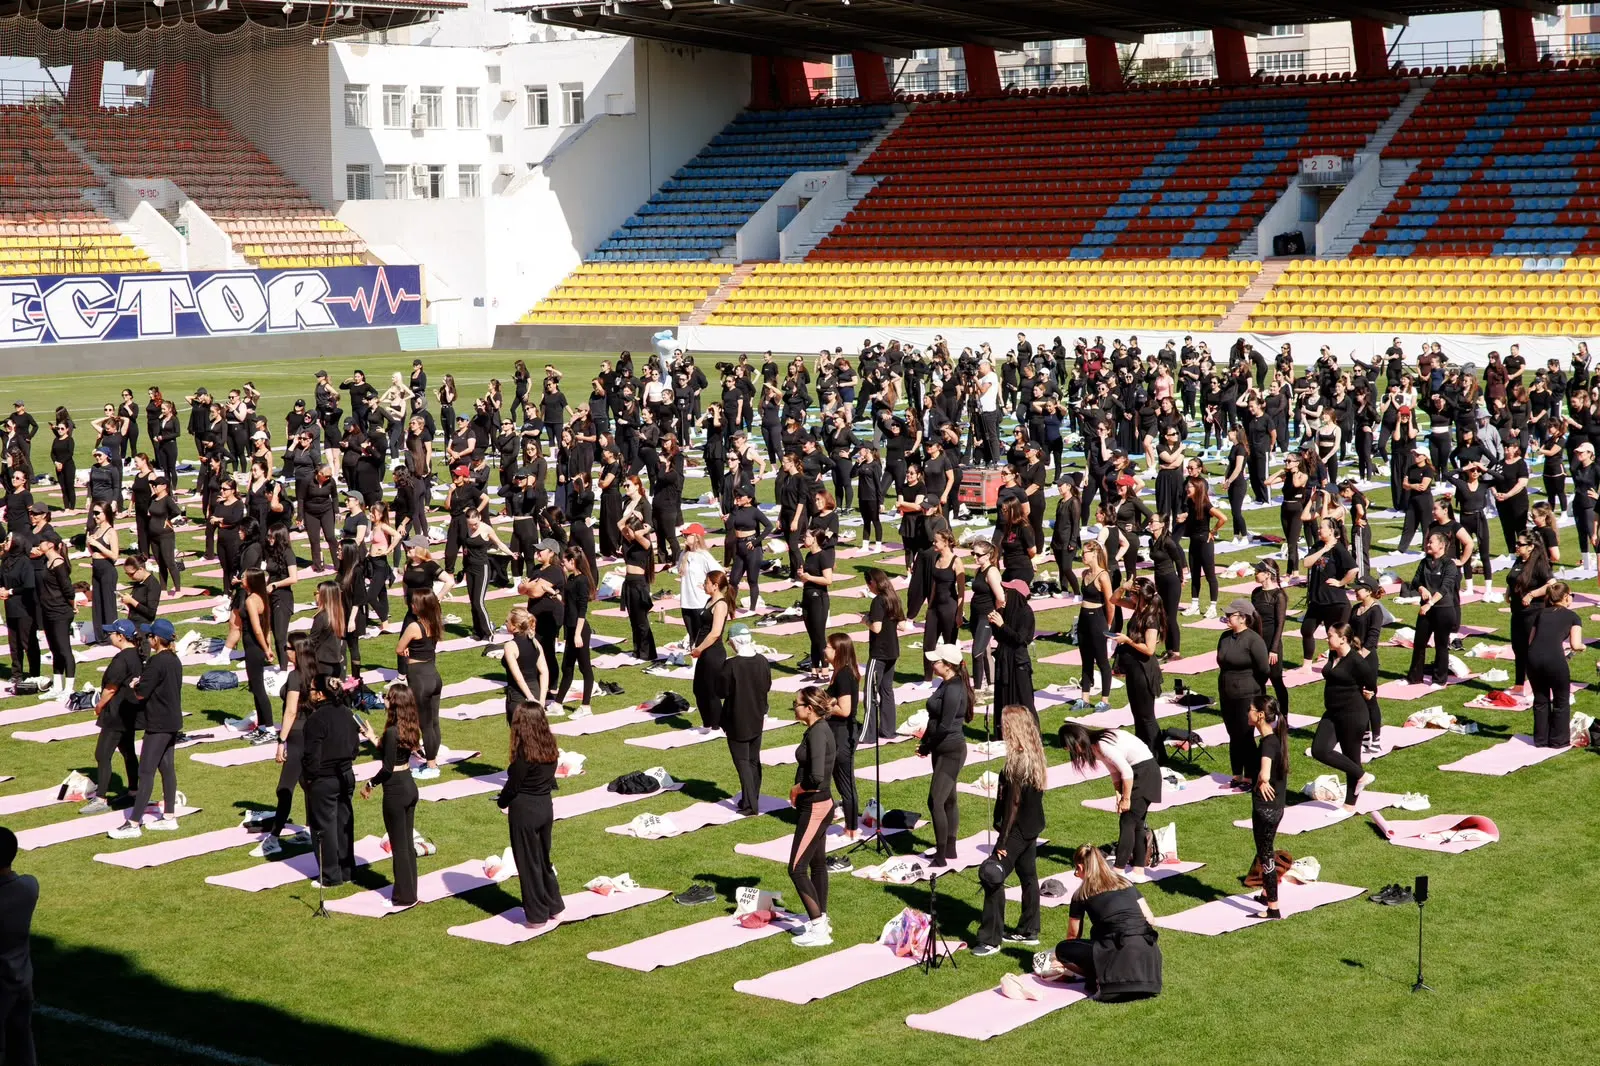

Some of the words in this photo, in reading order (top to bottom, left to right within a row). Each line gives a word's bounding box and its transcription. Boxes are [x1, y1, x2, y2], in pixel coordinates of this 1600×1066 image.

[1311, 160, 1318, 170] 2
[1327, 159, 1334, 170] 3
[741, 892, 756, 900] ARE
